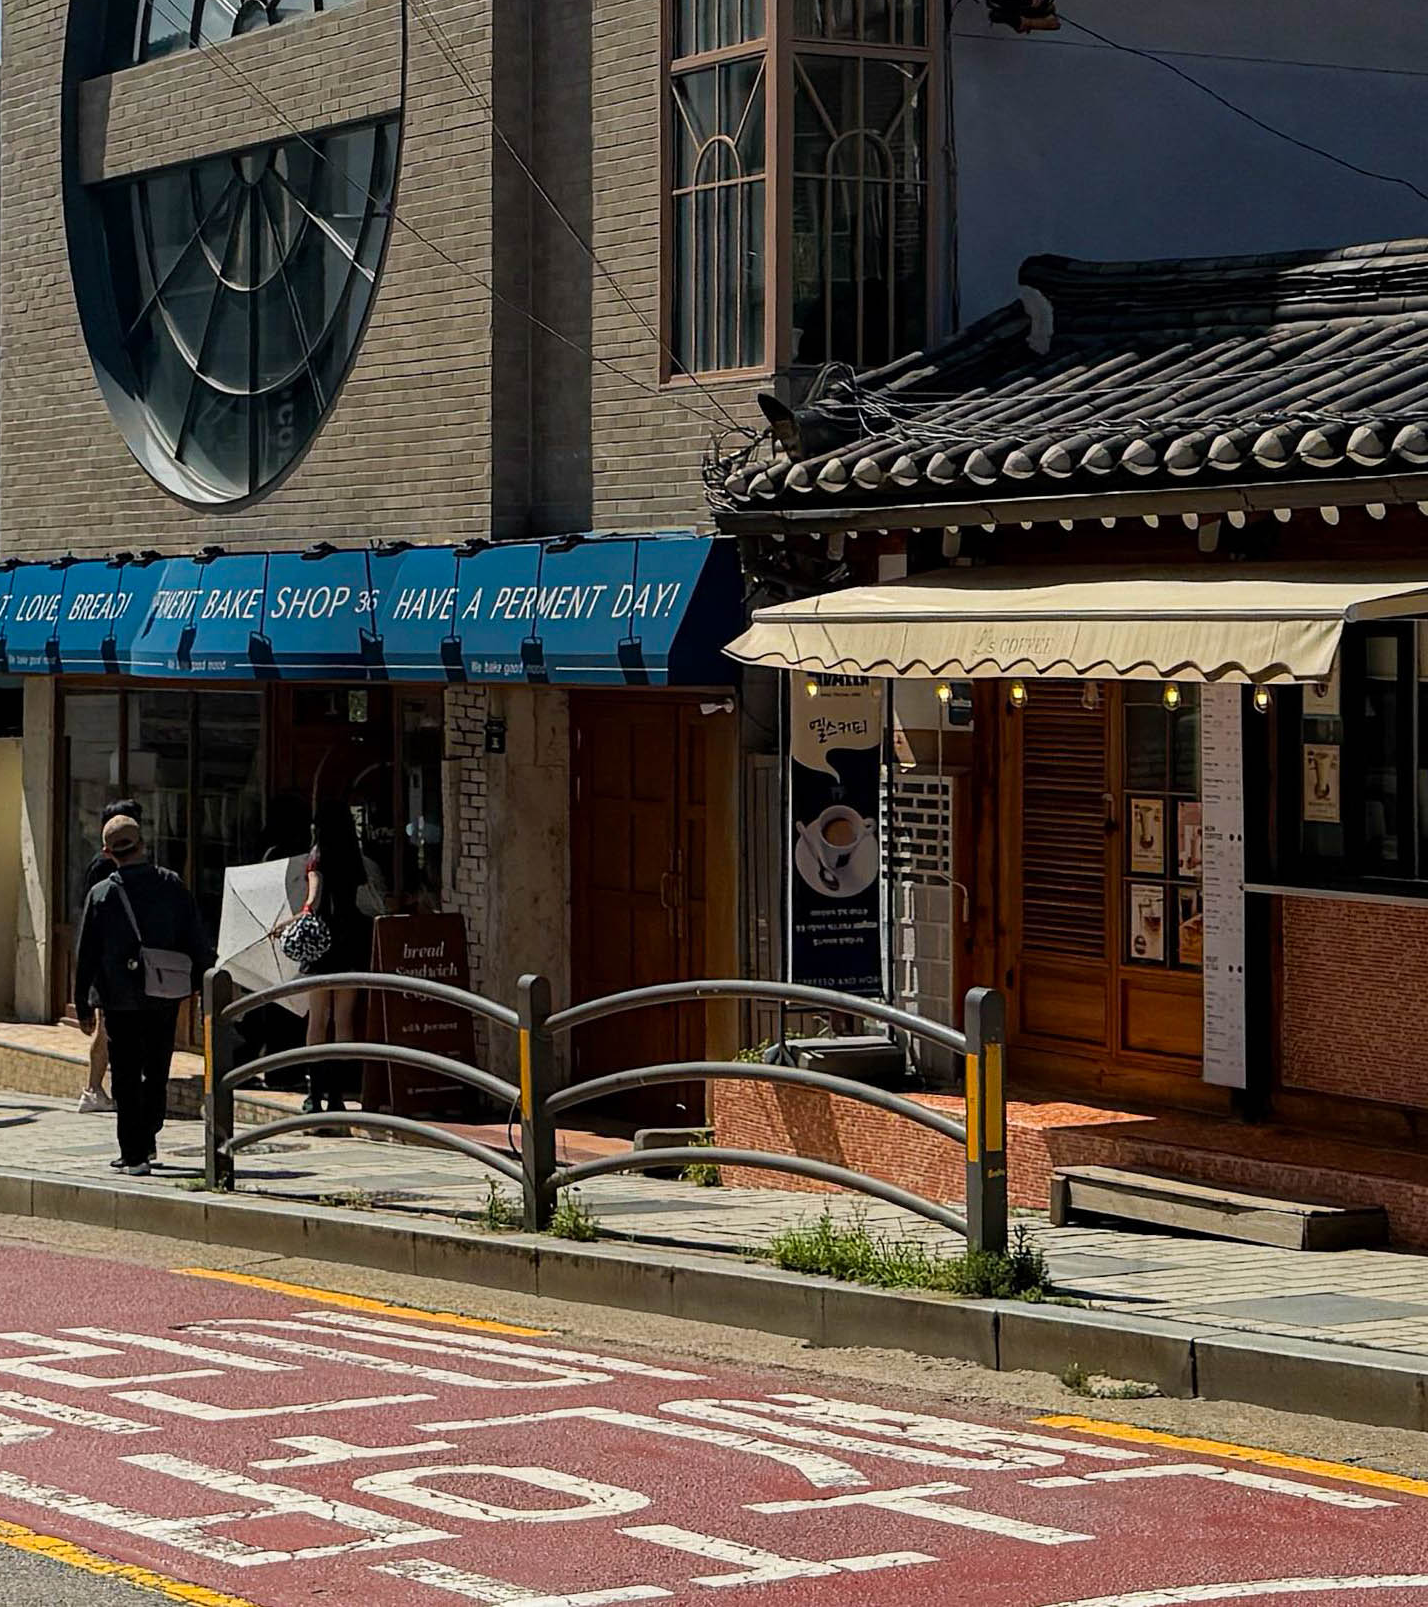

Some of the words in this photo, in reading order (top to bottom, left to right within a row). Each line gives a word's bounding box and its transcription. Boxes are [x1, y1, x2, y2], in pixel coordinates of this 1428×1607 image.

[15, 594, 62, 625] LOVE,
[68, 592, 133, 621] BREAD!
[202, 589, 264, 619] BAKE
[270, 586, 350, 620] SHOP
[354, 589, 380, 614] 36
[392, 587, 459, 620] HAVE
[463, 587, 483, 620] A
[490, 584, 607, 620] PERMENT
[610, 582, 682, 620] DAY!
[808, 717, 867, 743] 엘스커피
[402, 940, 445, 960] bread
